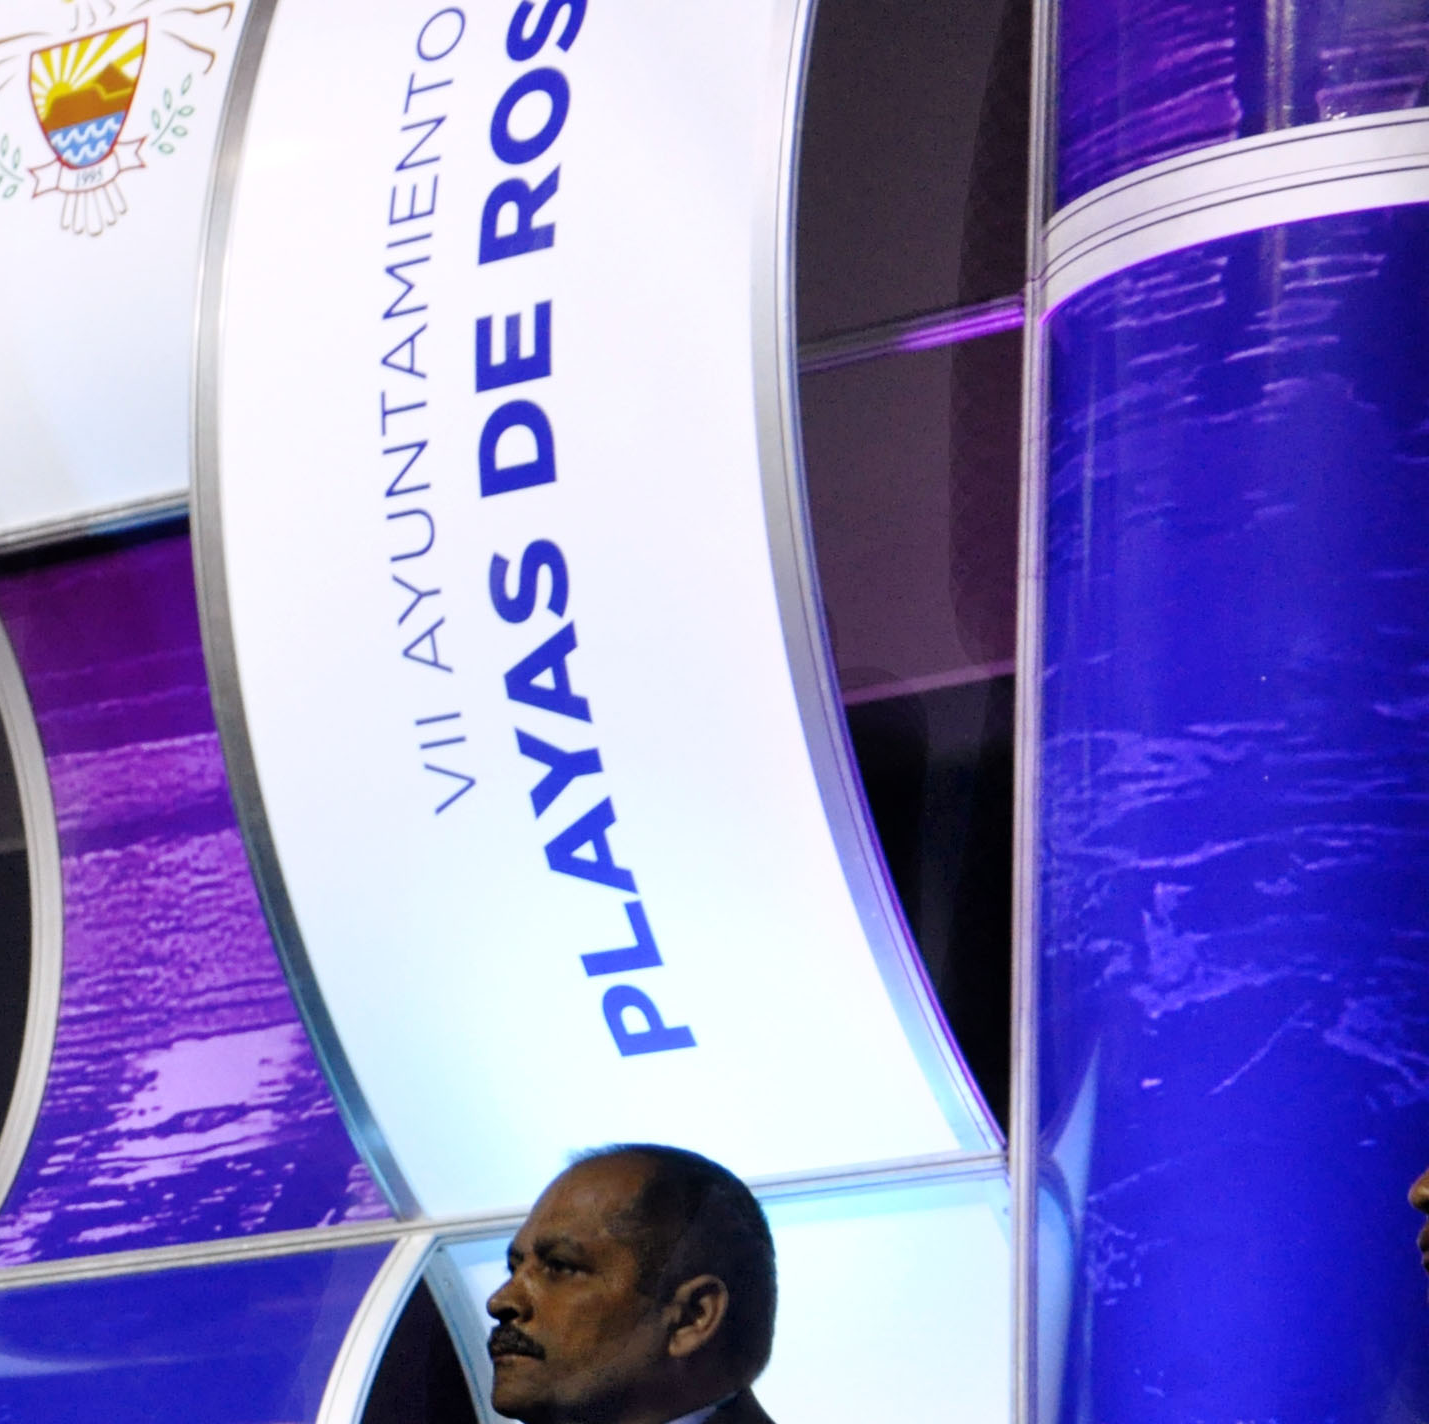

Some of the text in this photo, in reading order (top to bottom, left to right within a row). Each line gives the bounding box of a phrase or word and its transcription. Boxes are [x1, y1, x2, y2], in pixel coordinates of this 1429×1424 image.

[380, 7, 477, 815] VII AYUNTAMIENTO
[475, 299, 558, 499] DE
[488, 537, 699, 1058] PLAYAS
